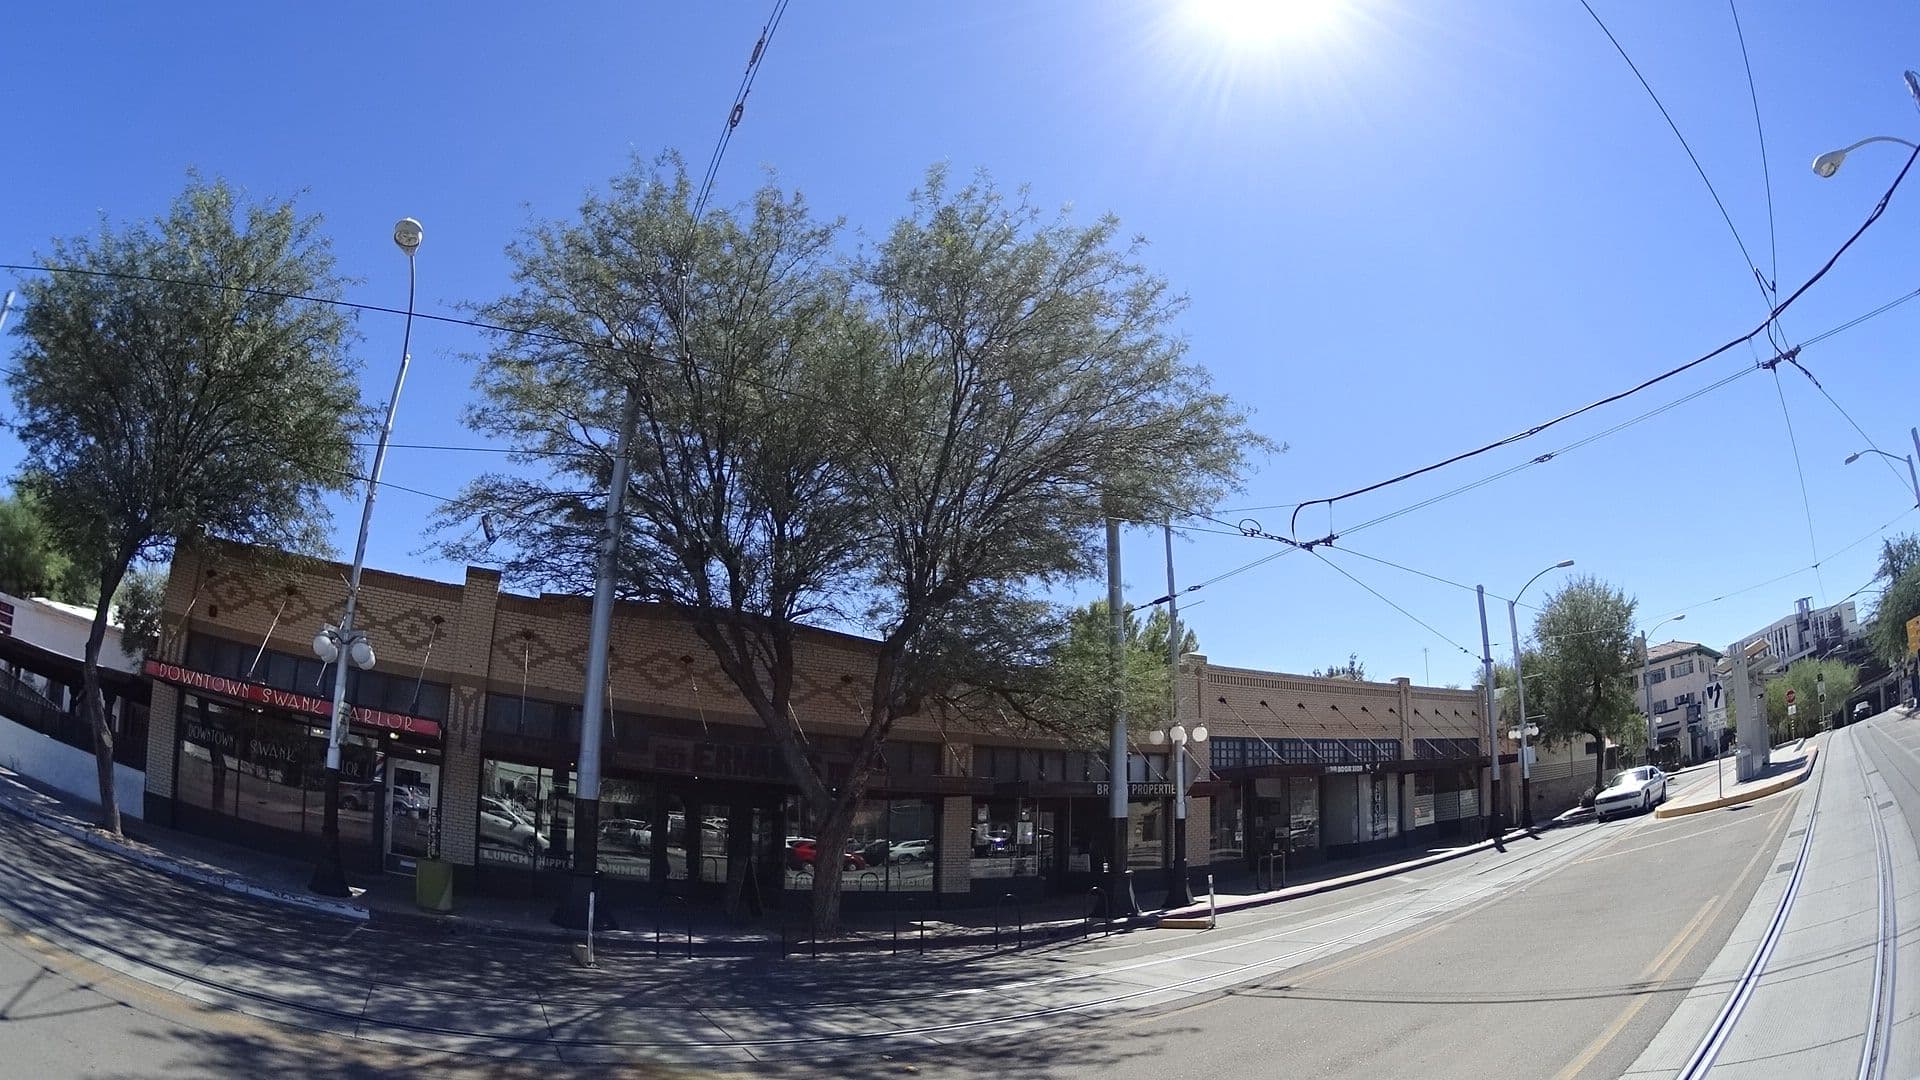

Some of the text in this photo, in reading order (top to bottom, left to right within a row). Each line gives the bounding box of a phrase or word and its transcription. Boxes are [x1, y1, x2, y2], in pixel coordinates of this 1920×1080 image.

[159, 663, 250, 698] DOWNTOWN
[262, 688, 324, 714] SWANK
[350, 707, 416, 732] ARLOR
[249, 739, 297, 763] SWANK
[1132, 783, 1176, 795] PROPERTIE
[484, 849, 529, 864] LUNCH
